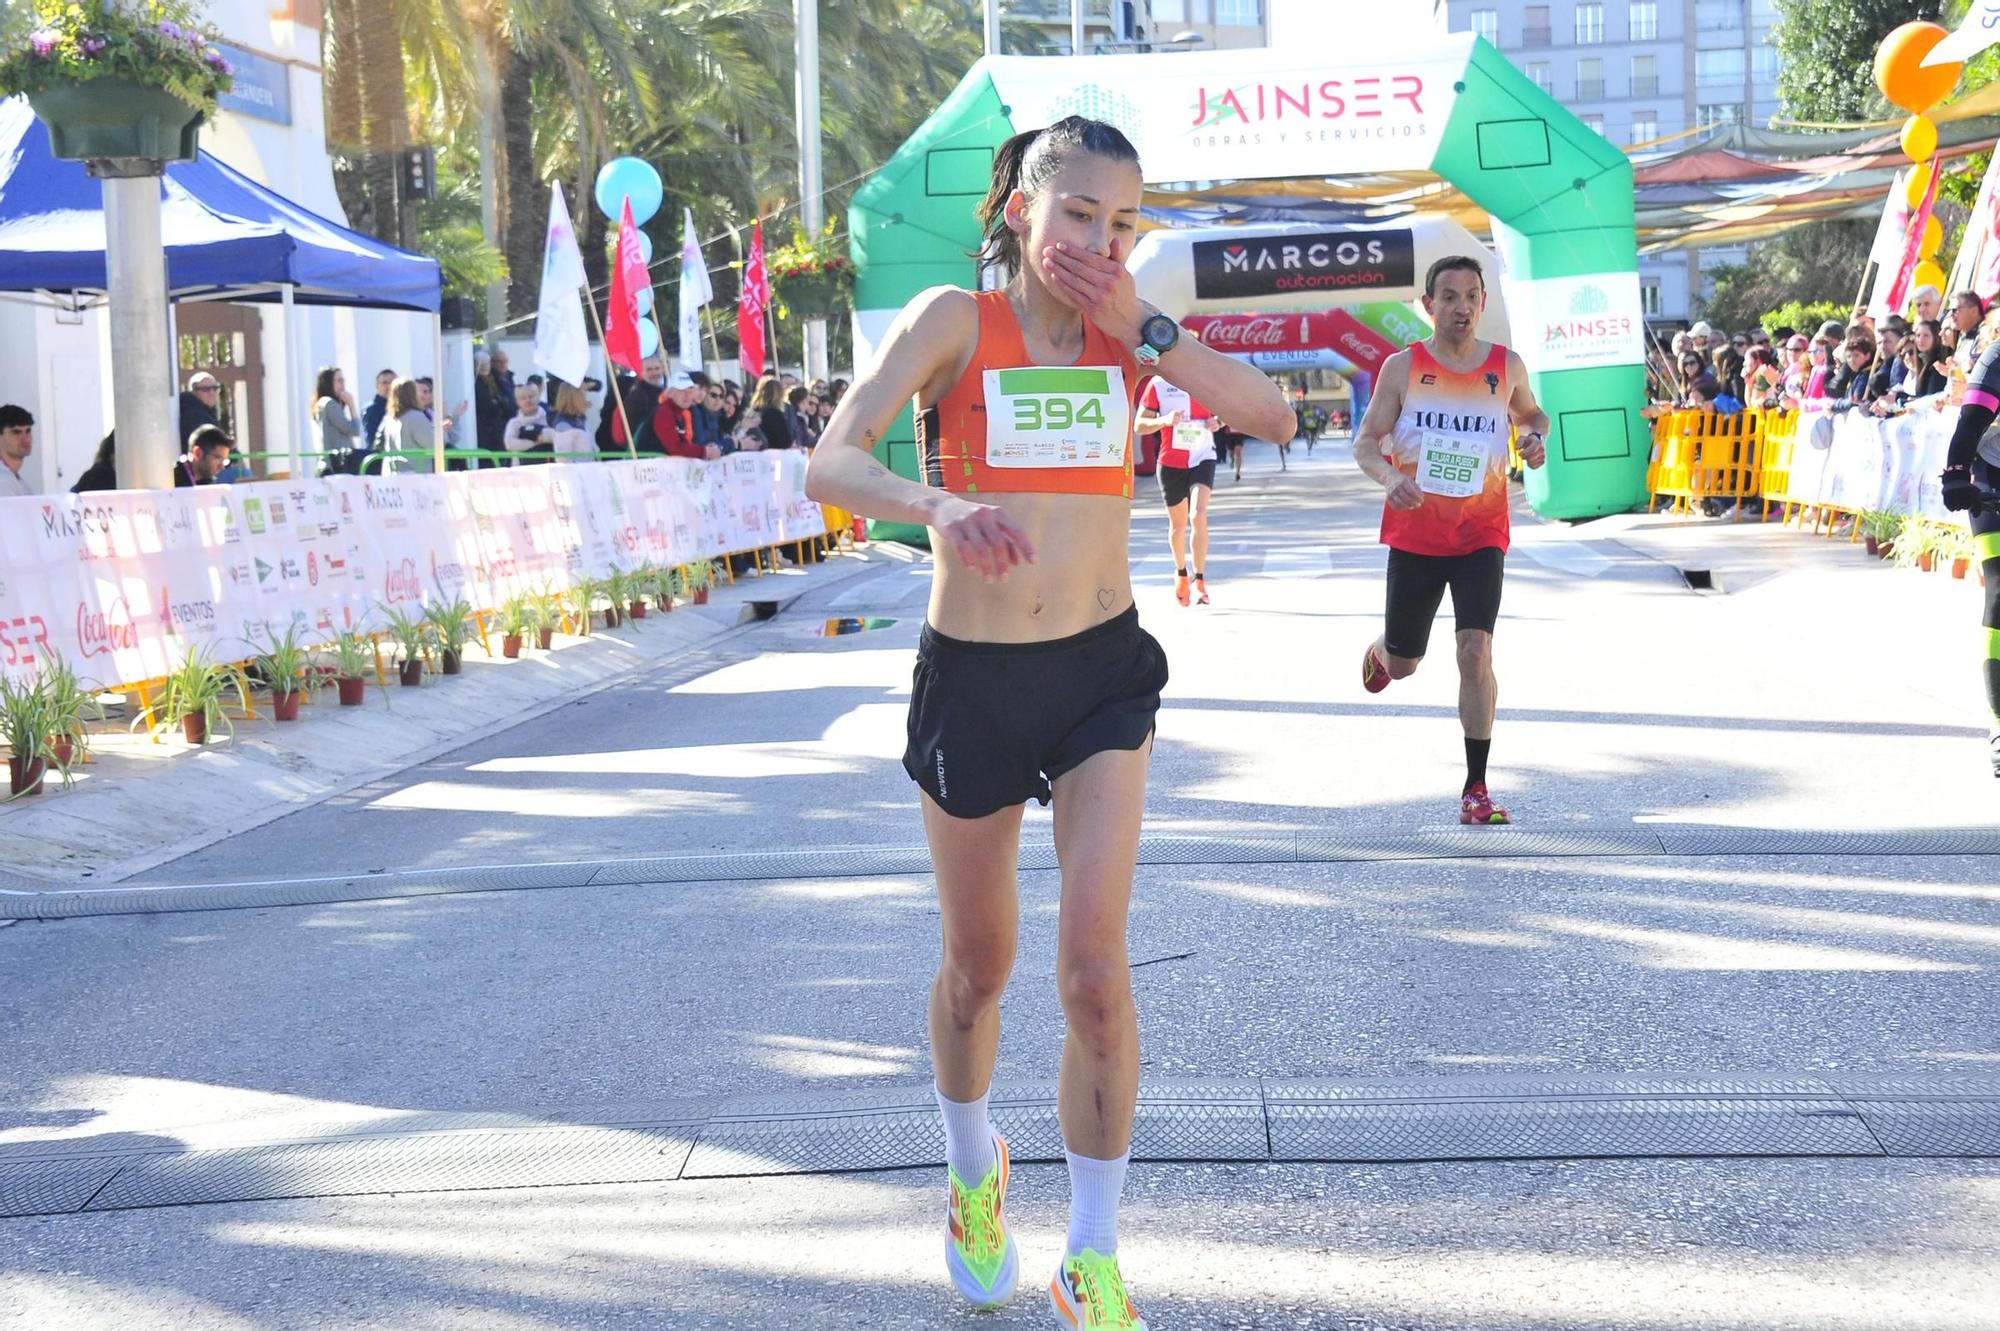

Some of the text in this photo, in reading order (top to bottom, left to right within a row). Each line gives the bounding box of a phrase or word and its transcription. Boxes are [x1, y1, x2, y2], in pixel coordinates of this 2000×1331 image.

[1193, 76, 1424, 126] JAINSER
[1193, 124, 1427, 148] OBRAS Y SERVICIOS
[1223, 240, 1384, 273] MARCOS
[1275, 271, 1385, 289] automación
[1545, 318, 1632, 341] JAINSER
[1262, 349, 1319, 360] EVENTOS
[1012, 398, 1106, 431] 394
[1414, 410, 1496, 434] TOBARRA
[1428, 464, 1472, 483] 268
[171, 600, 215, 623] EVENTOS
[935, 748, 948, 798] SALOMON
